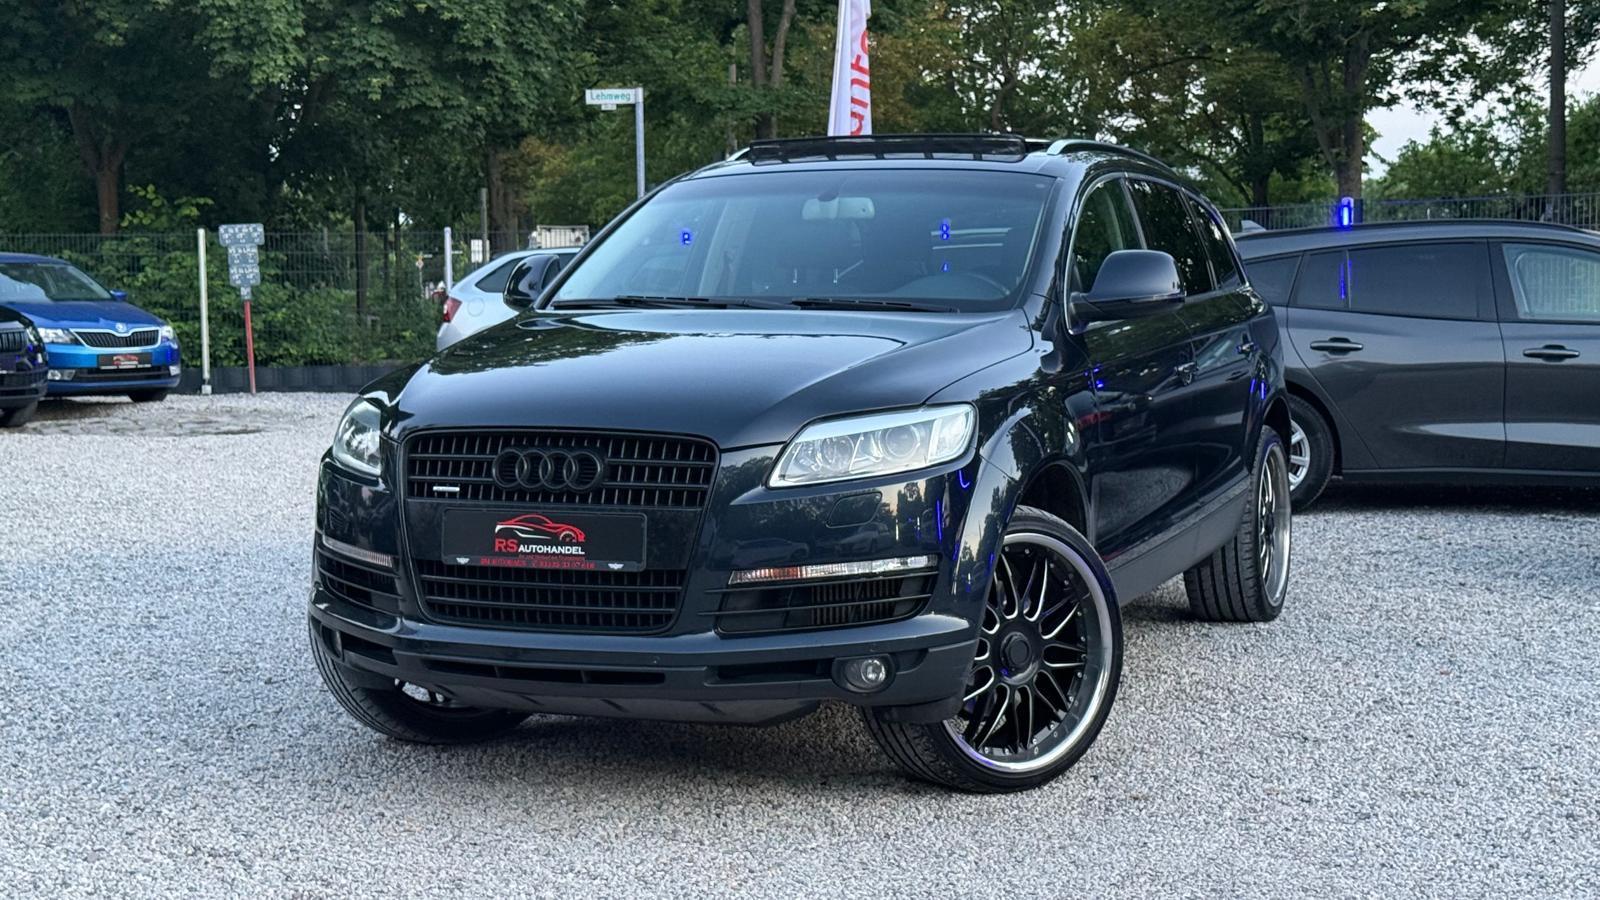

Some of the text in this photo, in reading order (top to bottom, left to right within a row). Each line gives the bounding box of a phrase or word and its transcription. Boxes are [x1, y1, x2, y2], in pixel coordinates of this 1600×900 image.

[591, 91, 631, 102] Lehmweg
[494, 538, 586, 555] RS AUTOHANDEL
